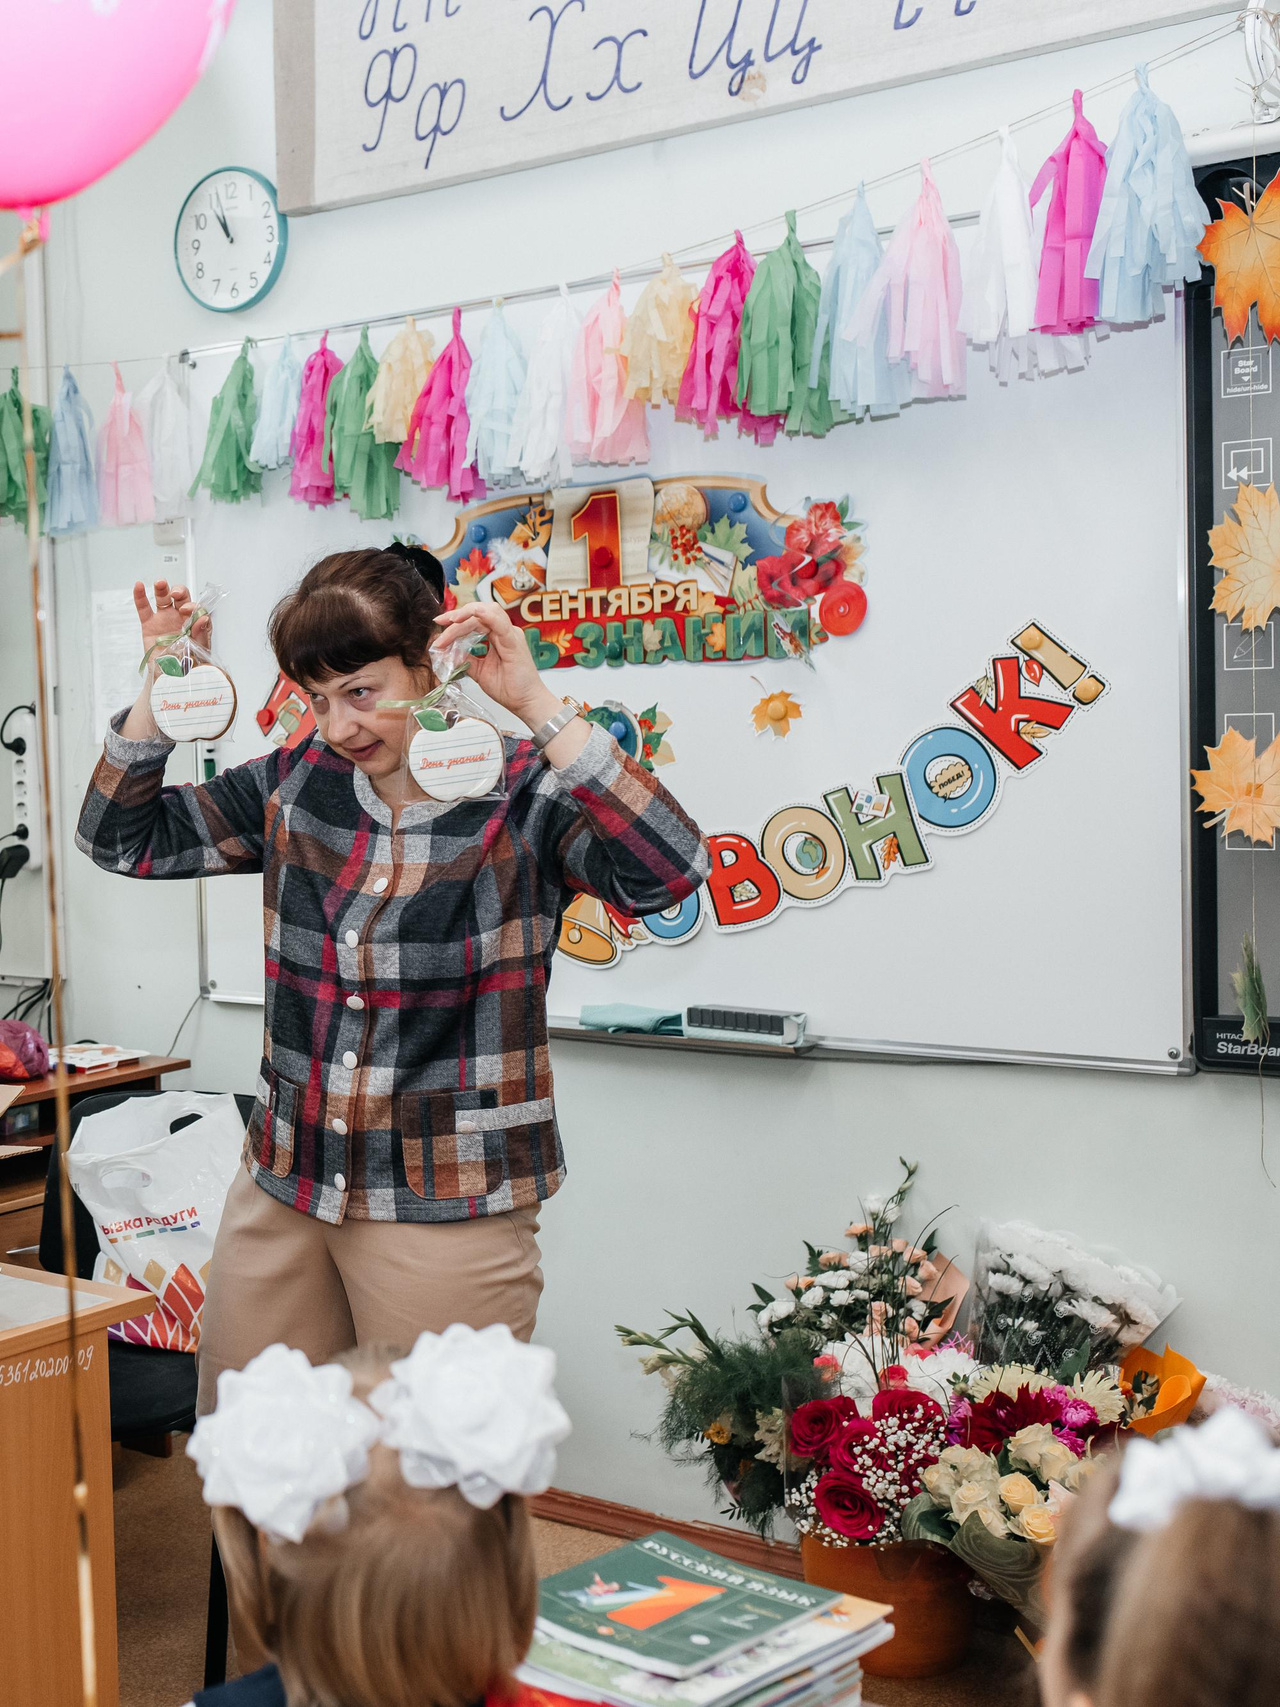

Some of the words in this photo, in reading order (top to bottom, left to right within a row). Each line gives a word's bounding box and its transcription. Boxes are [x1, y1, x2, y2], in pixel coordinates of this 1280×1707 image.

[224, 181, 238, 200] 12
[261, 200, 272, 219] 2
[194, 212, 208, 231] 10
[265, 224, 275, 243] 3
[191, 238, 201, 257] 9
[263, 251, 272, 266] 4
[195, 261, 205, 280] 8
[249, 271, 259, 289] 5
[211, 278, 221, 296] 7
[229, 281, 240, 299] 6
[1234, 365, 1258, 375] Board
[1237, 359, 1255, 368] Star
[570, 489, 623, 590] 1
[520, 579, 698, 623] СЕНТЯБРЯ
[160, 699, 182, 712] День
[183, 694, 223, 712] знаний!
[419, 757, 444, 770] День
[446, 748, 491, 770] знаний!
